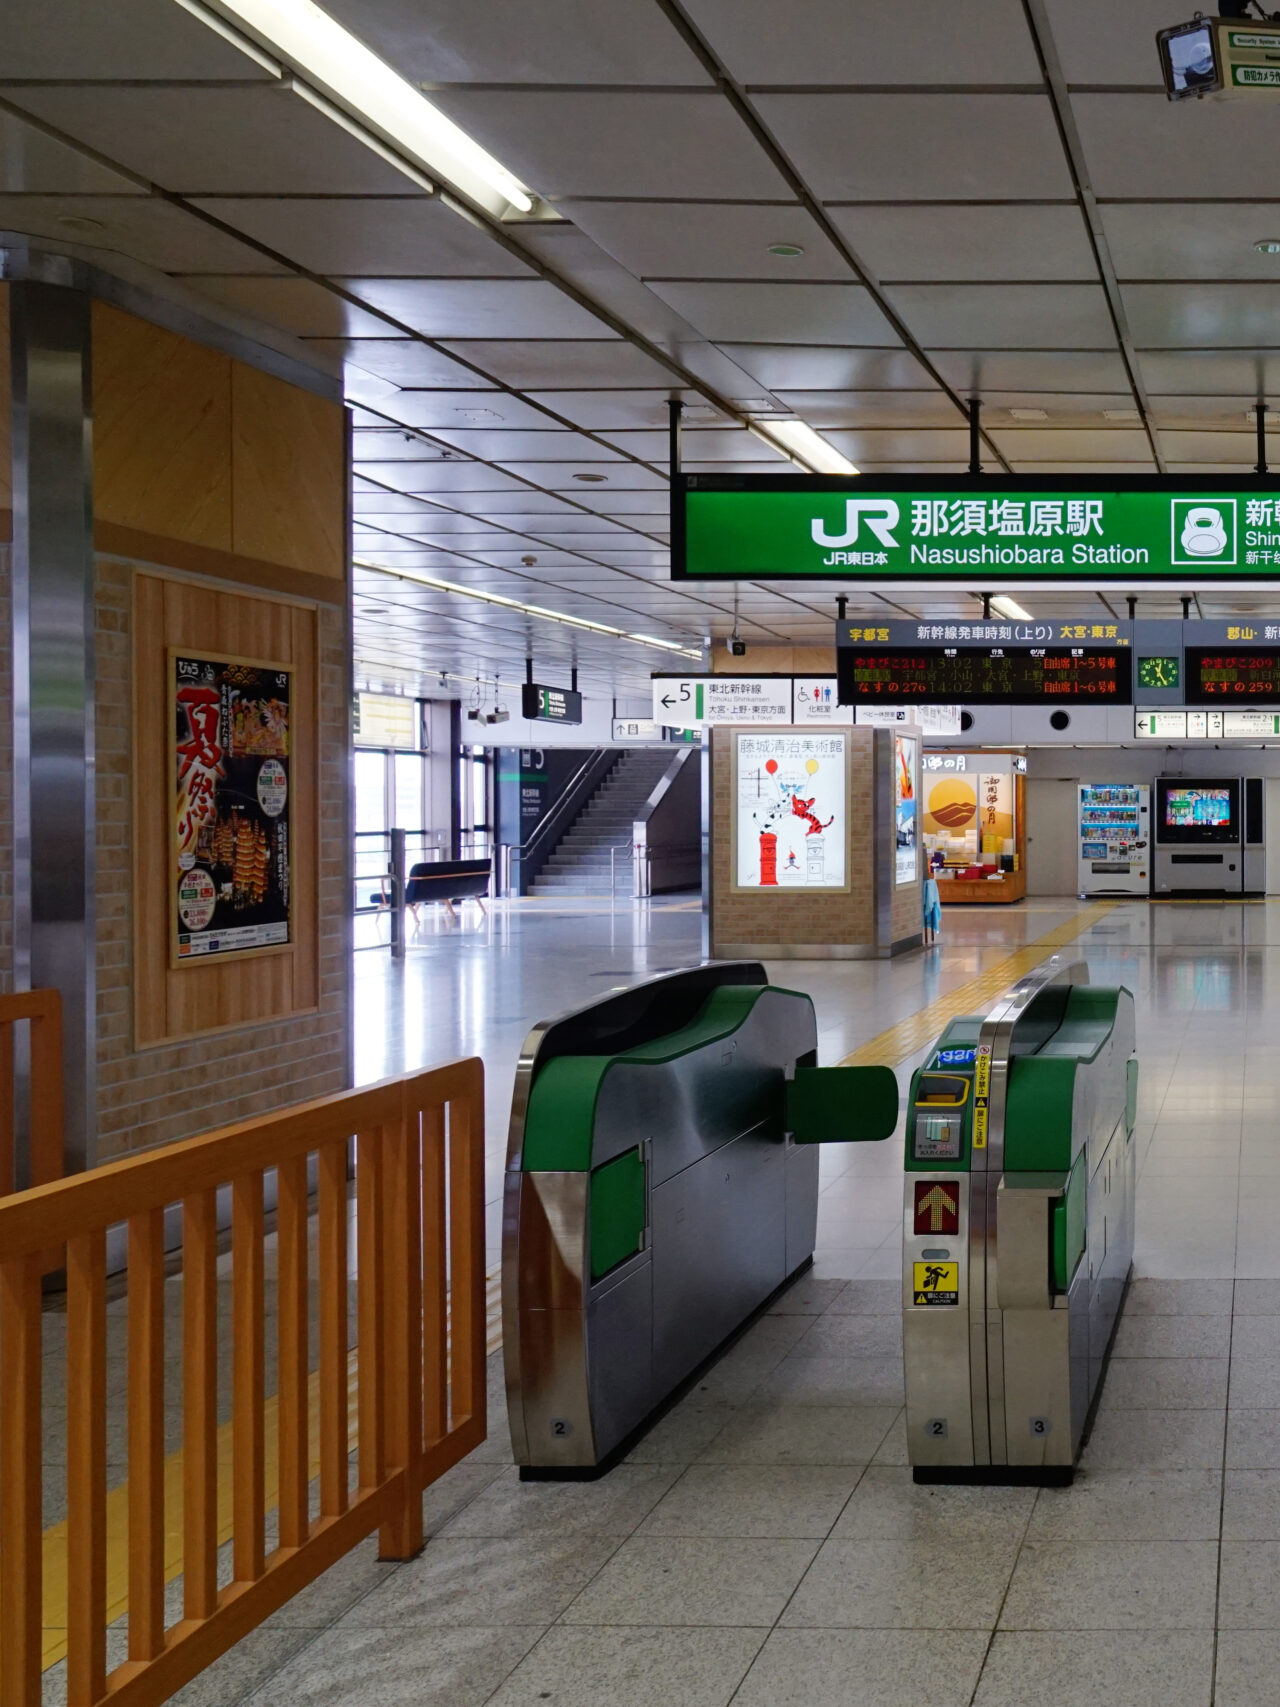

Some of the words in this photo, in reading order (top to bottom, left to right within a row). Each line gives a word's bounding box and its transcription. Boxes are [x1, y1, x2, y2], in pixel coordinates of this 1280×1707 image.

[811, 499, 900, 548] JR
[910, 499, 1104, 538] 那須塩原駅
[823, 552, 889, 566] JR東日本
[910, 544, 1065, 566] Nasushiobara
[1071, 544, 1149, 566] Station
[849, 627, 890, 642] 宇都宮
[917, 625, 1053, 641] 新幹線発車時刻（上り）
[1059, 625, 1118, 640] 大宮・東京
[679, 683, 691, 701] 5
[708, 683, 763, 695] 東北新幹線
[708, 705, 786, 714] 大宮・上野・東京方面
[740, 738, 843, 753] 藤城清治美術館
[922, 755, 966, 771] 邸の月
[978, 1055, 988, 1095] かけこみ禁止
[554, 1421, 566, 1435] 2
[932, 1421, 944, 1435] 2
[1034, 1420, 1045, 1433] 3
